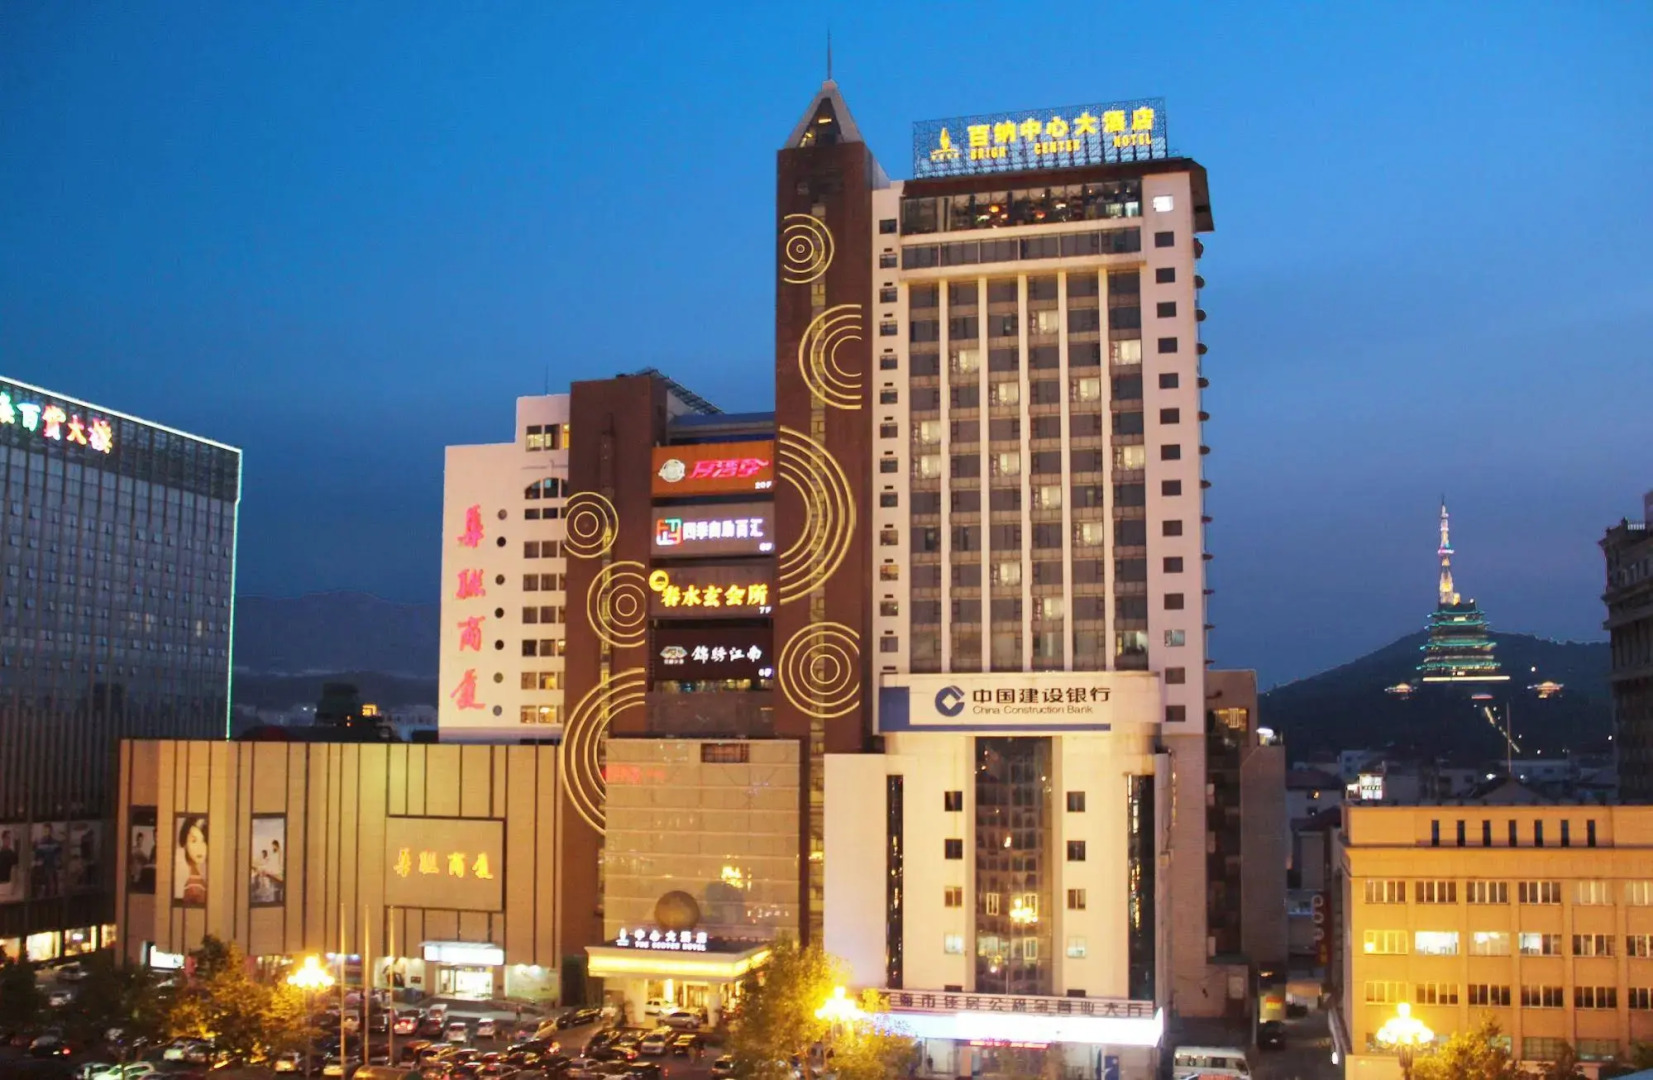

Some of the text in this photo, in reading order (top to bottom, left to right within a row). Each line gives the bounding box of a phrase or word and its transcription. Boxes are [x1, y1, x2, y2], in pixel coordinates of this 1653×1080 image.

[1034, 139, 1080, 155] CENTER
[1113, 133, 1152, 148] HOTEL
[973, 686, 1111, 704] 中国建设银行
[973, 705, 1093, 715] China Construction Bank
